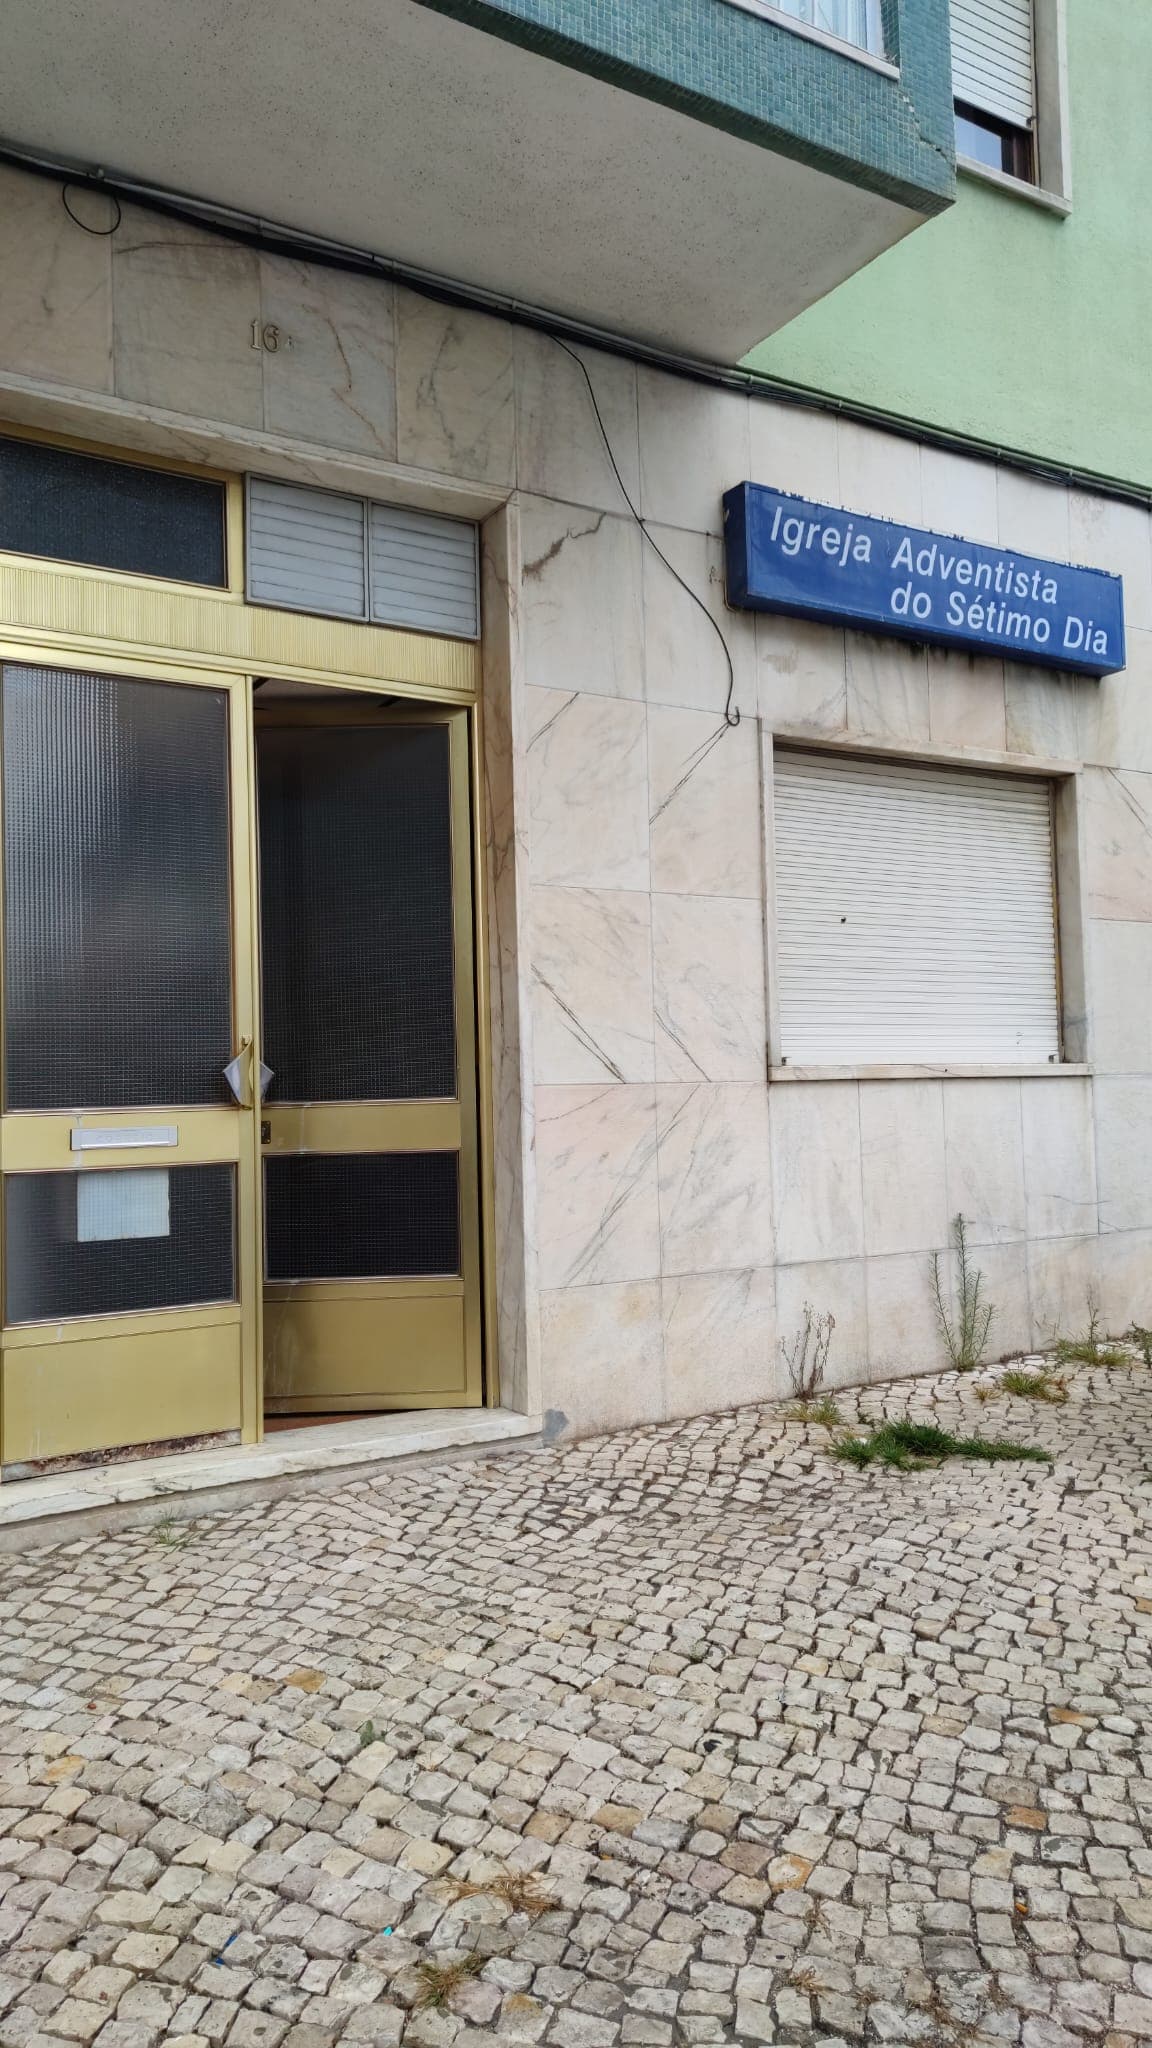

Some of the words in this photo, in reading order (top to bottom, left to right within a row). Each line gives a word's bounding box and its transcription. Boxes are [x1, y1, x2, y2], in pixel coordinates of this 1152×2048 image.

[250, 319, 280, 353] 16
[770, 506, 871, 566] Igreja
[892, 537, 1058, 604] Adventista
[891, 582, 931, 619] do
[946, 591, 1051, 643] Sétimo
[1063, 616, 1108, 655] Dia
